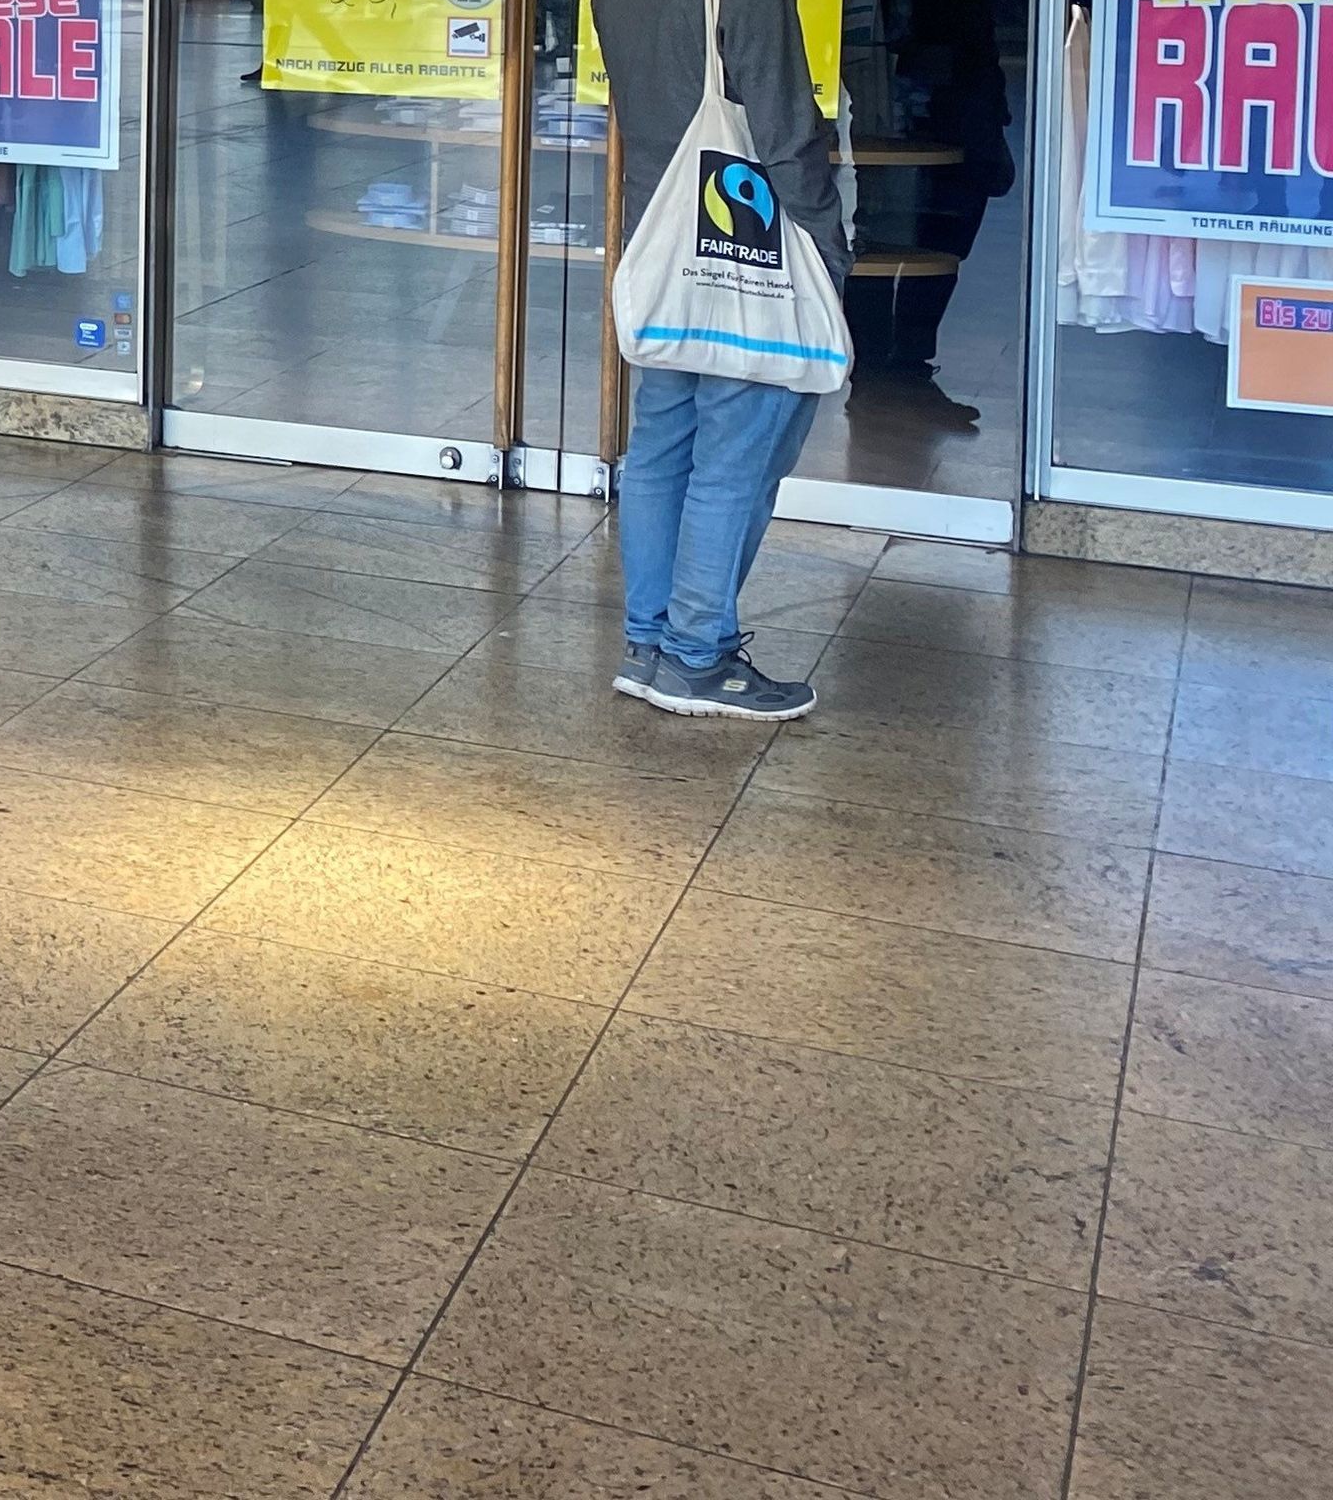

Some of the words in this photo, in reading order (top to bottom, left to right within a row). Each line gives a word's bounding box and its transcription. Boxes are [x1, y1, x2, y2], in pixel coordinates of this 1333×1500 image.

[276, 58, 312, 70] NACH
[317, 60, 365, 73] ABZUG
[1191, 217, 1254, 231] TOTALER
[1259, 219, 1333, 236] RÄUMUNG
[700, 238, 778, 264] FAIRTRADE
[682, 268, 698, 276] Das
[700, 268, 725, 280] Siegel
[767, 280, 794, 290] Hande
[1260, 299, 1296, 328] Bis
[1301, 308, 1333, 330] zu
